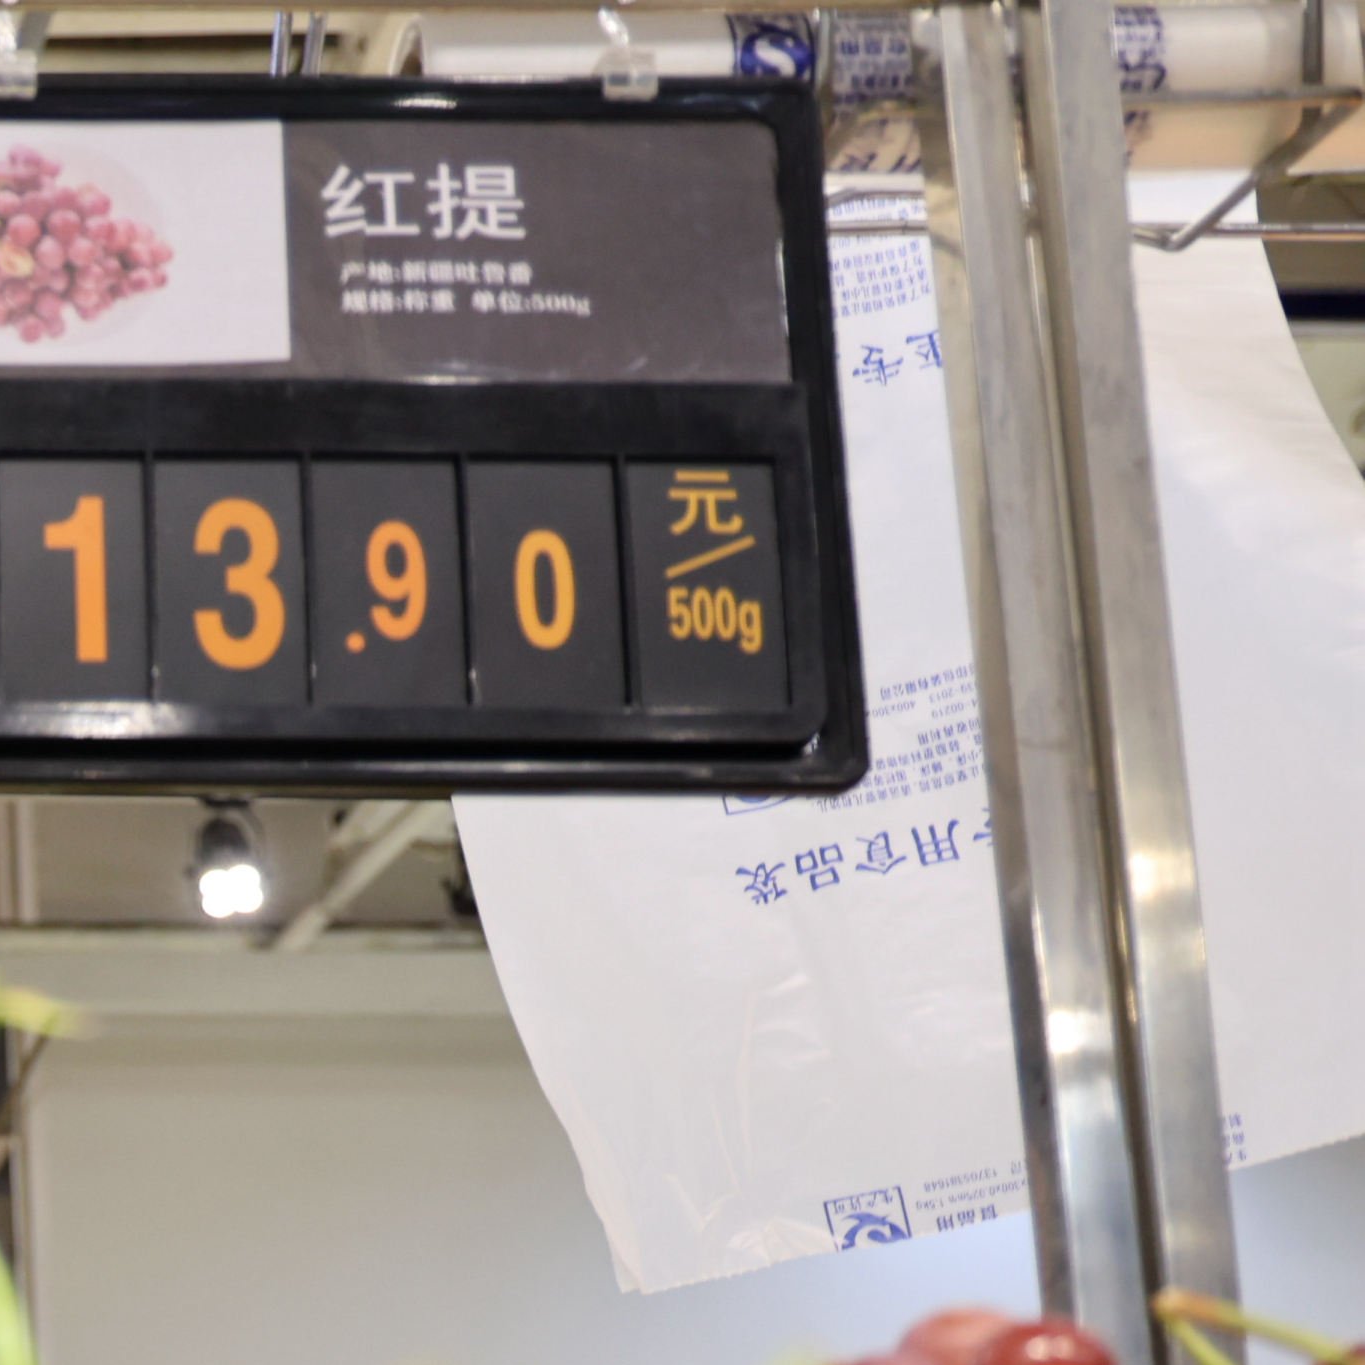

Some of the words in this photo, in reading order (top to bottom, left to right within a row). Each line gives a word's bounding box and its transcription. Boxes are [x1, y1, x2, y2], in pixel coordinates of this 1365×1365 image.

[320, 162, 526, 240] 红提
[879, 663, 975, 701] 印包装有限公司
